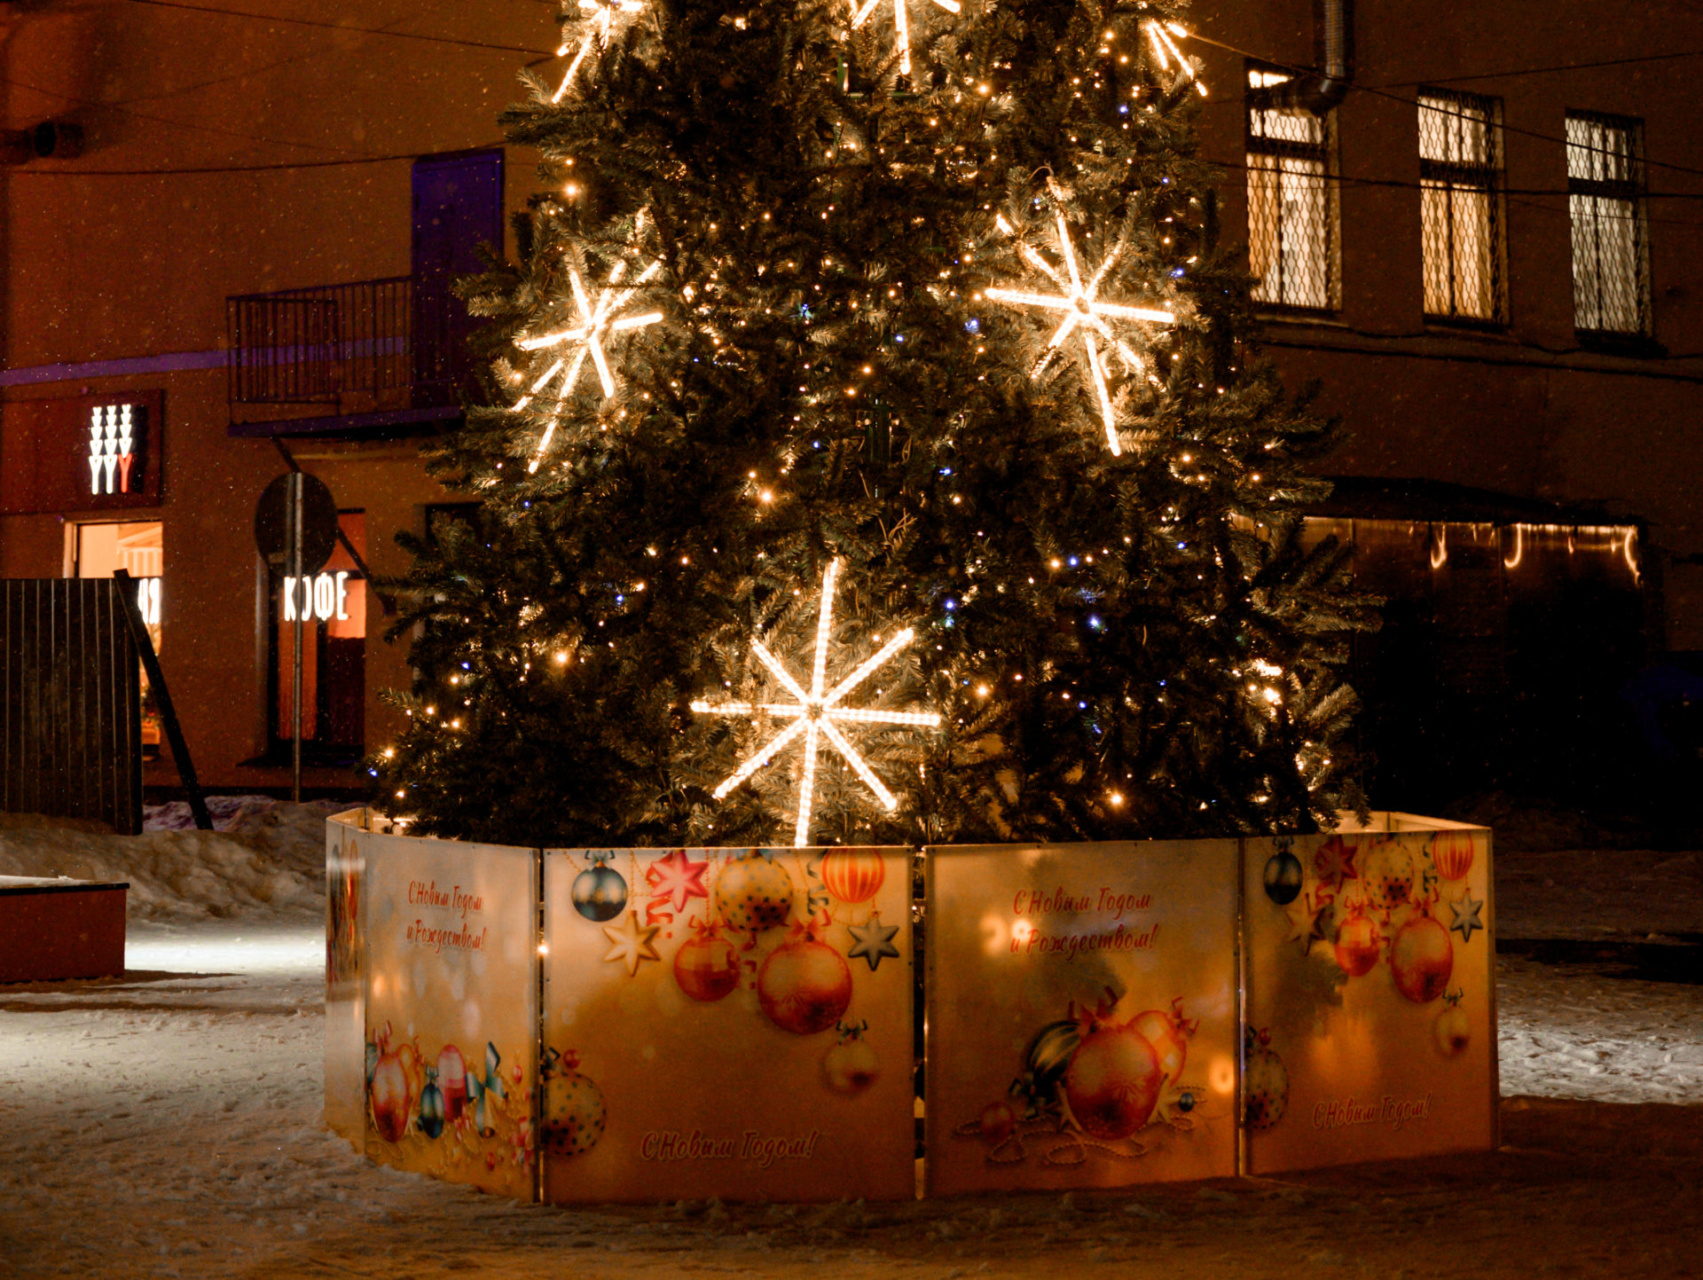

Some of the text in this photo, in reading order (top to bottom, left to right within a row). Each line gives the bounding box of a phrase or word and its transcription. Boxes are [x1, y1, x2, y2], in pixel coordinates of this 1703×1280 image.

[452, 885, 482, 919] Годом
[1028, 886, 1090, 915] Новым
[1097, 886, 1151, 920] Годом
[415, 919, 487, 954] Рождеством!
[1026, 923, 1160, 961] Рождеством!
[741, 1129, 818, 1168] Годом!
